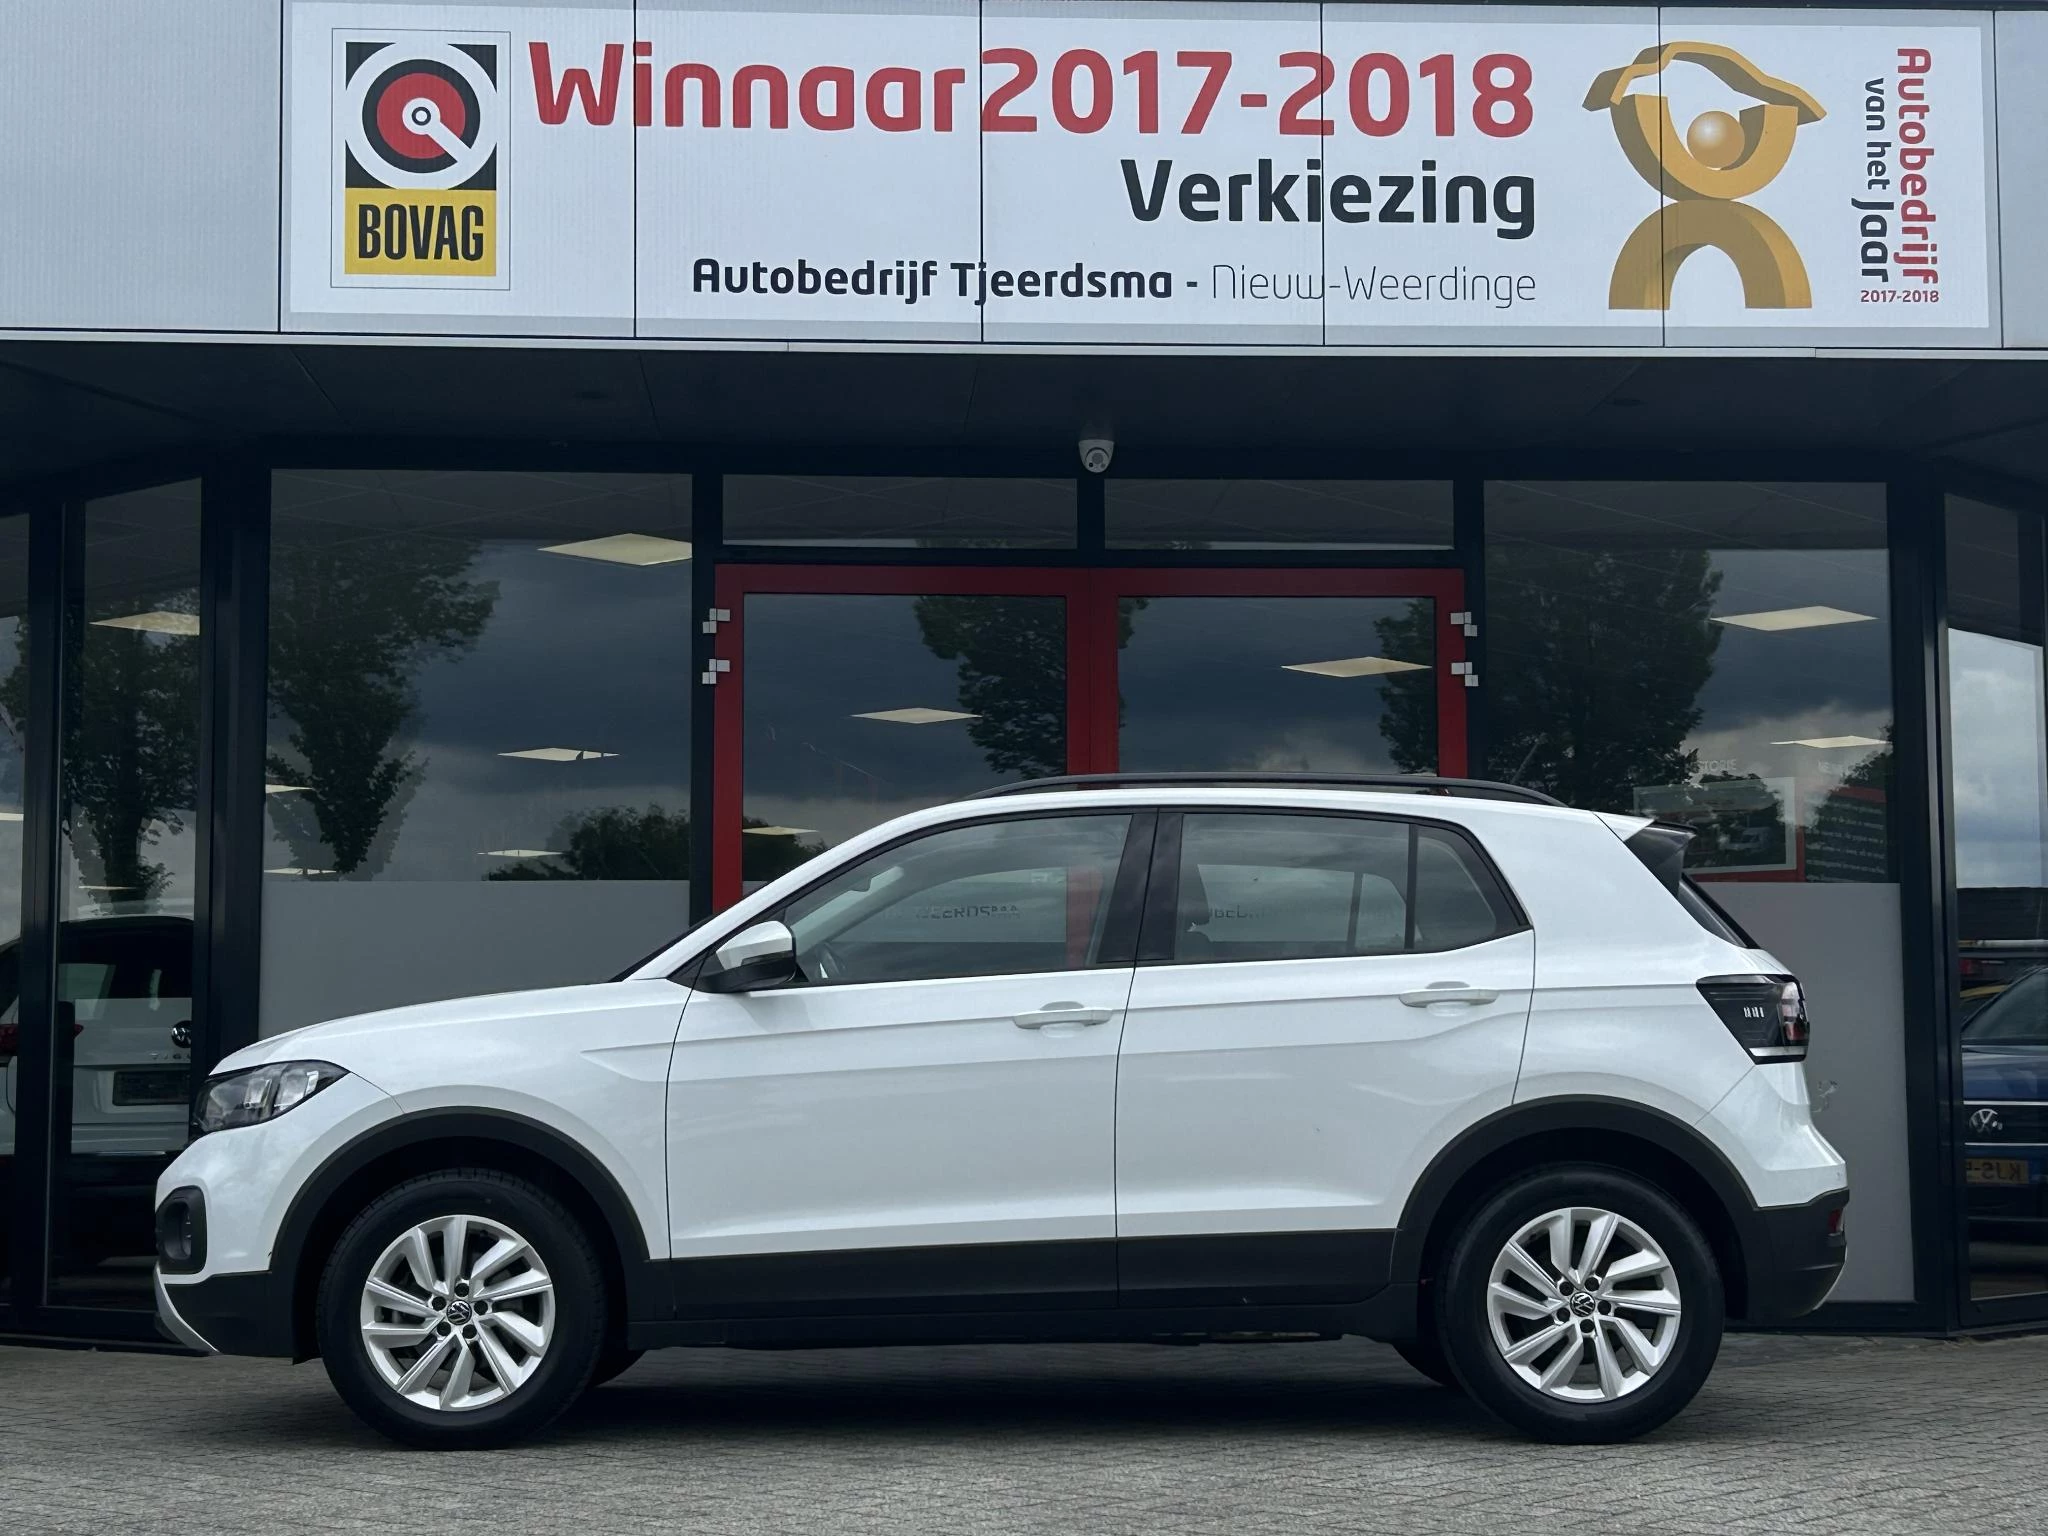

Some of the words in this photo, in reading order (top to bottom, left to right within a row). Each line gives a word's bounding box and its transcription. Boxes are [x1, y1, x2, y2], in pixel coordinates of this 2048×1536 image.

[528, 41, 966, 132] Winnaar
[980, 48, 1534, 138] 2017-2018
[1864, 77, 1886, 131] van
[1866, 141, 1892, 190] het
[1893, 48, 1939, 284] Autobedrijf
[1120, 158, 1536, 240] Verkiezing
[357, 203, 485, 262] BOVAG
[1851, 197, 1895, 283] Jaar
[692, 257, 939, 305] Autobedrijf
[950, 262, 1173, 306] Tjeerdsma
[1211, 263, 1537, 309] Nieuw-Weerdinge
[1860, 288, 1940, 303] 2017-2018
